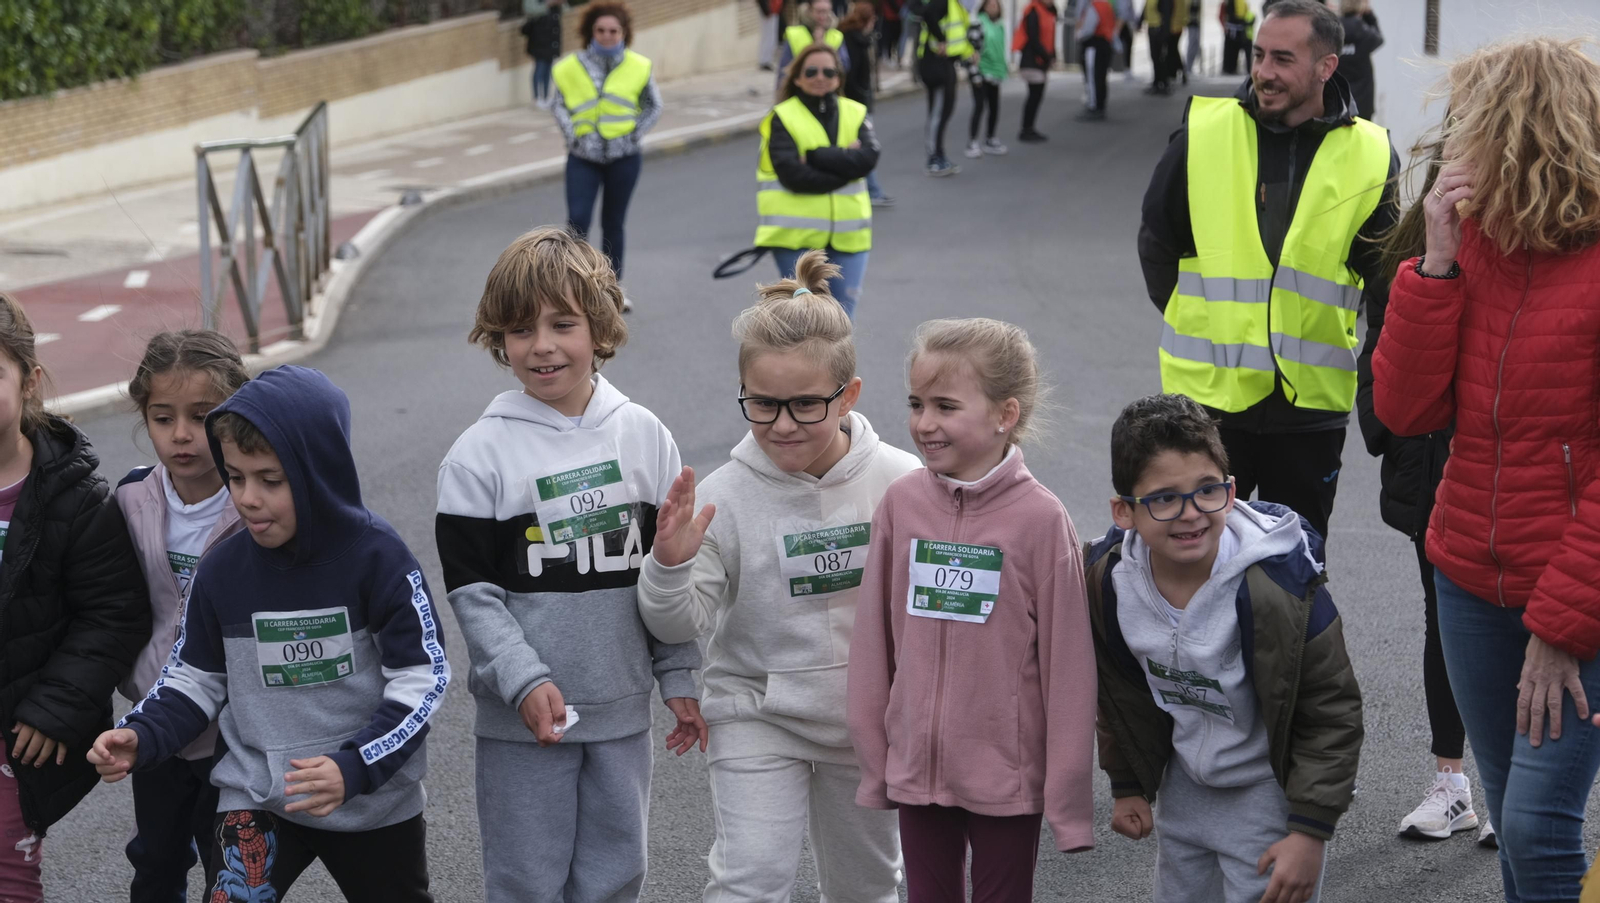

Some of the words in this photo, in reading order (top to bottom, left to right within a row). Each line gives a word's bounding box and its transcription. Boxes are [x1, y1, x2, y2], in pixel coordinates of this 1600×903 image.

[552, 471, 581, 484] CARRERA
[581, 463, 613, 477] SOLIDARIA
[570, 490, 607, 515] 092
[799, 532, 830, 542] CARRERA
[830, 526, 866, 537] SOLIDARIA
[525, 518, 643, 577] FILA
[929, 544, 956, 552] CARRERA
[958, 546, 995, 556] SOLIDARIA
[814, 550, 852, 574] 087
[934, 568, 974, 590] 079
[413, 592, 425, 604] 65
[300, 616, 336, 626] SOLIDARIA
[420, 603, 433, 629] UCB
[424, 628, 434, 641] 65
[283, 640, 324, 662] 090
[426, 642, 444, 664] UCB
[432, 664, 444, 676] 65
[424, 691, 438, 704] 65
[1174, 683, 1206, 700] 067
[413, 701, 432, 724] UCB
[406, 719, 418, 733] 65
[364, 742, 384, 761] UCB
[382, 738, 396, 750] 65
